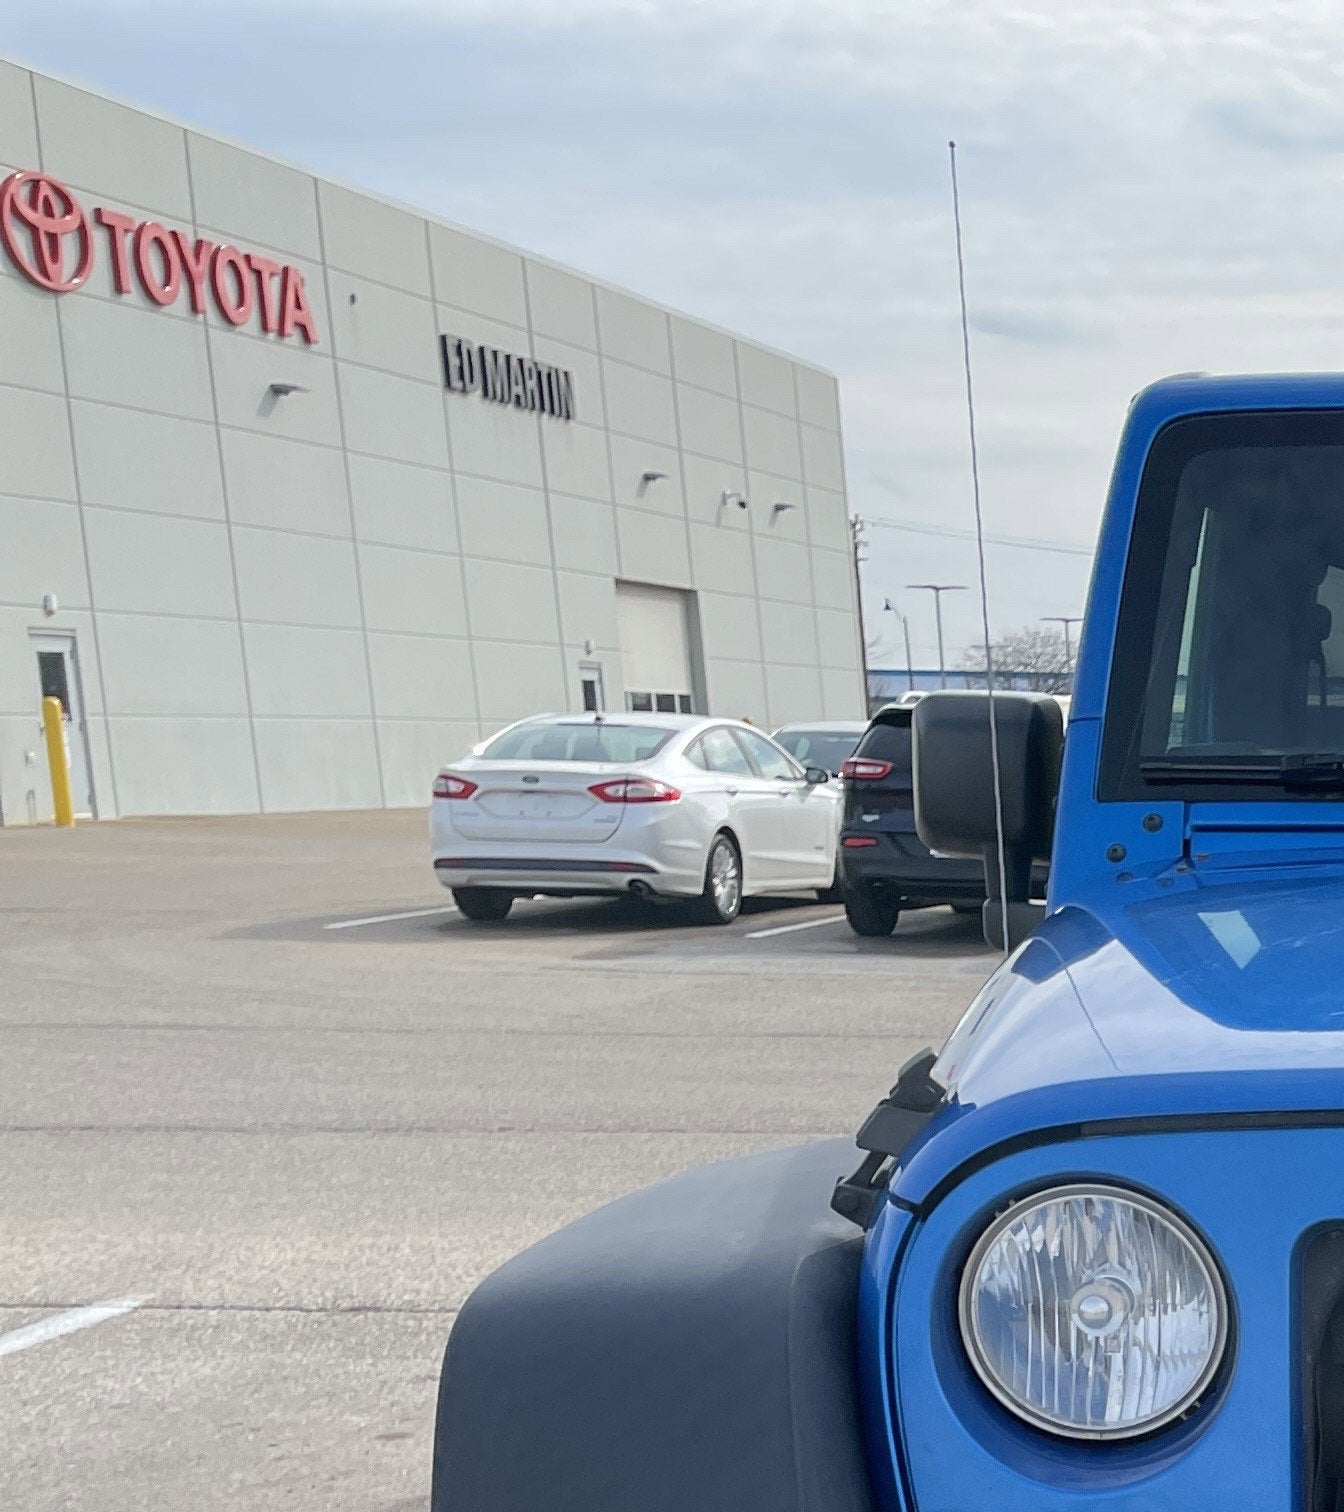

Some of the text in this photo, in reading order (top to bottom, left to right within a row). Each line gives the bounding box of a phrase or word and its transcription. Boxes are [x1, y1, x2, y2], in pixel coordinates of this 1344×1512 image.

[94, 207, 319, 345] TOYOTA
[439, 333, 577, 421] ED MARTIN
